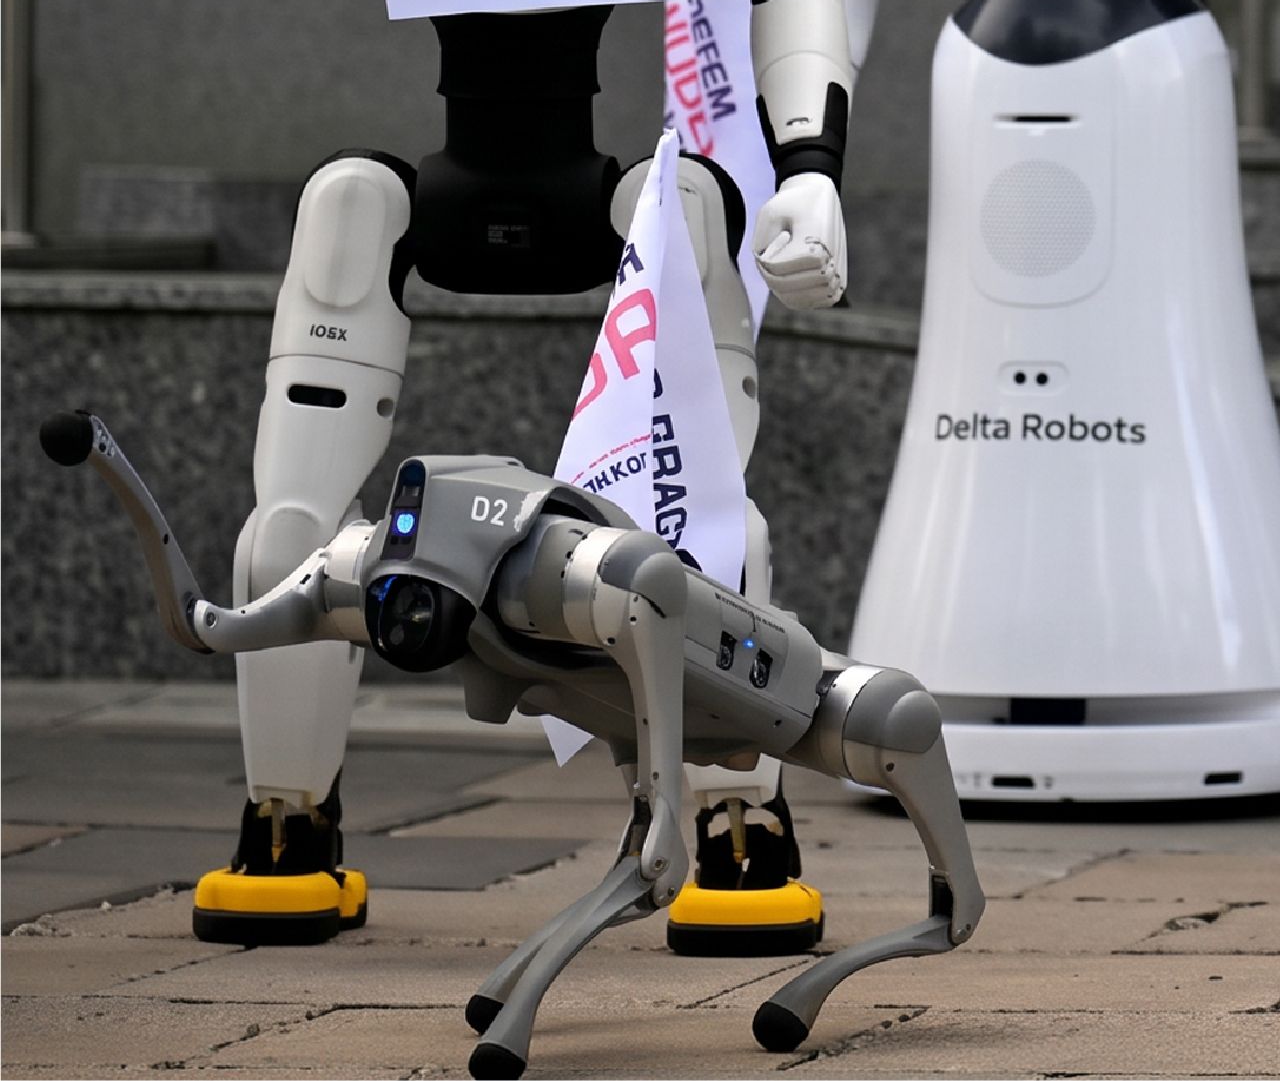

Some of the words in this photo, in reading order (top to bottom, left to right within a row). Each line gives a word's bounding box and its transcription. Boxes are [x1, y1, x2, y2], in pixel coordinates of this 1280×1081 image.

[936, 413, 1011, 440] Delta
[1022, 413, 1146, 444] Robots
[471, 495, 508, 527] D2
